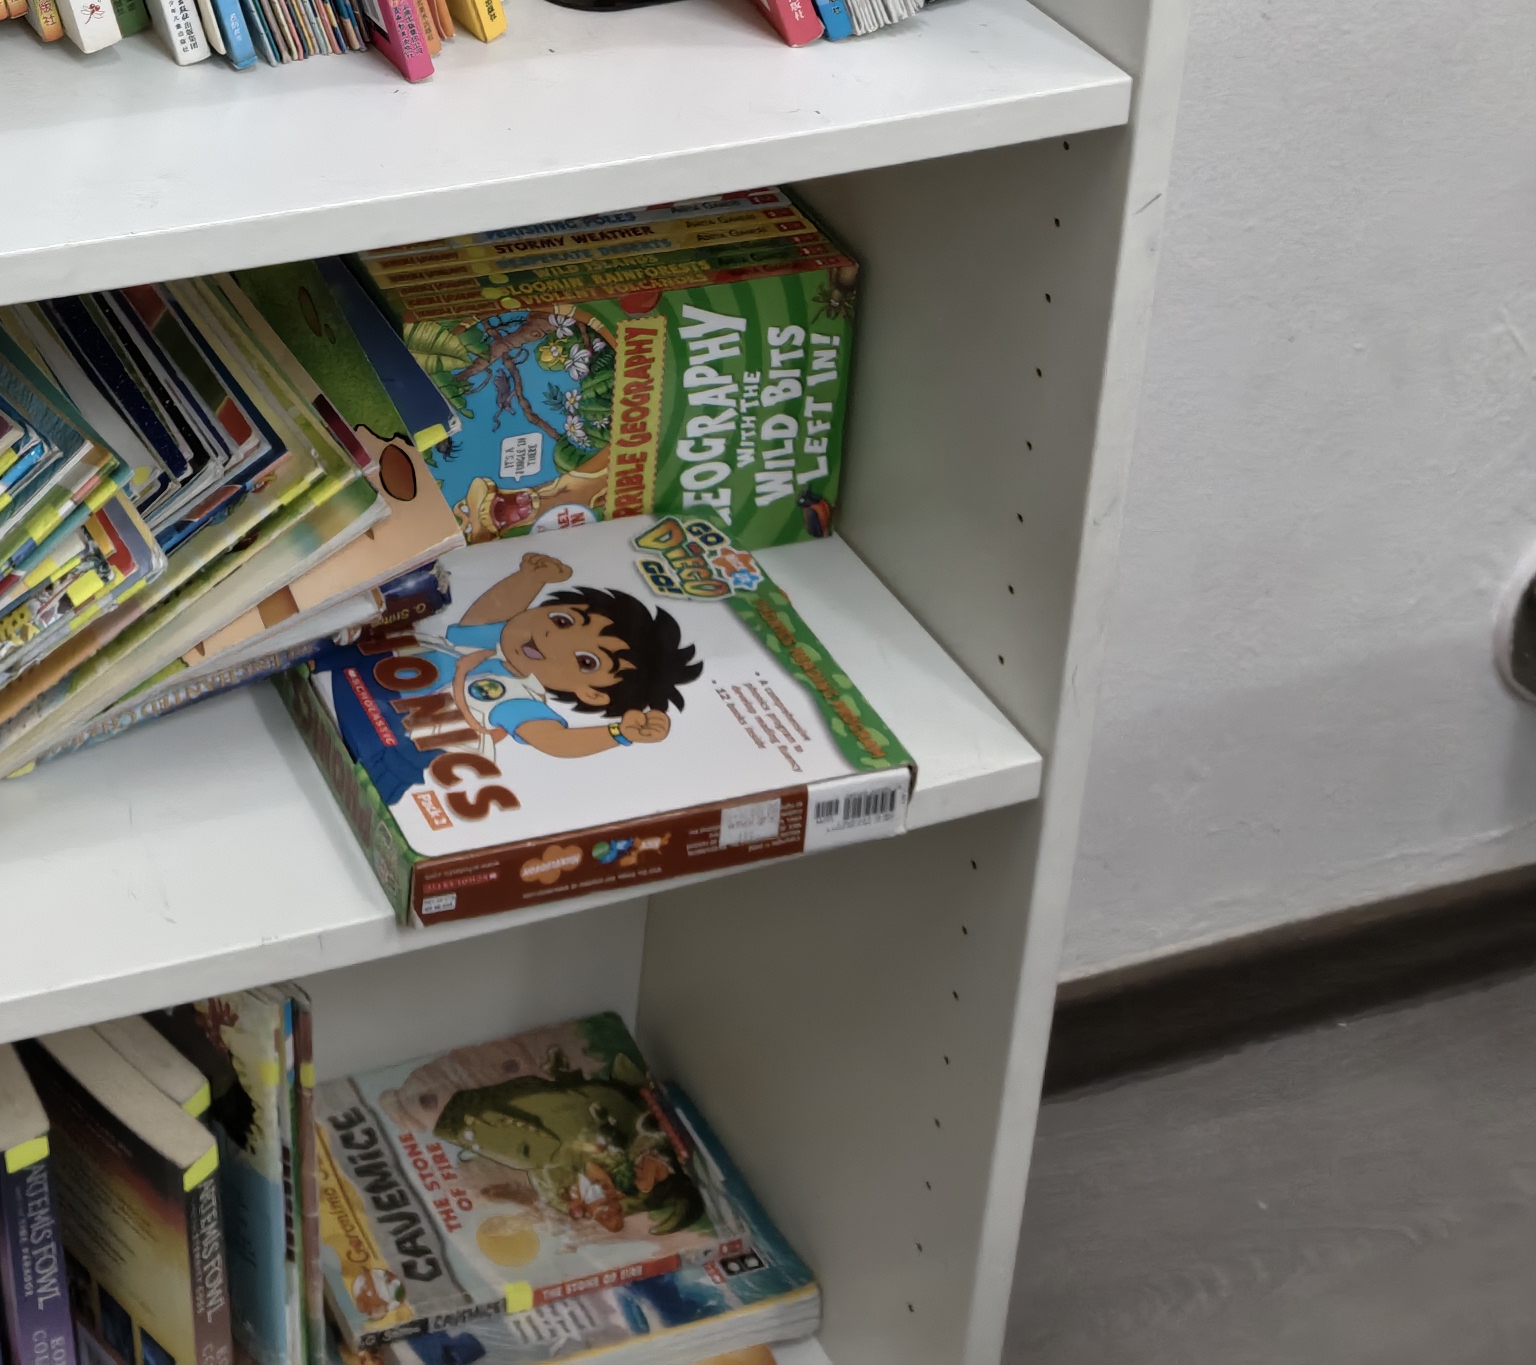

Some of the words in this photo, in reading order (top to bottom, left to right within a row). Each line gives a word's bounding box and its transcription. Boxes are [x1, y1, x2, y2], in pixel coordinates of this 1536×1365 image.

[495, 236, 566, 255] STORMY
[571, 225, 655, 247] WEATHER
[761, 325, 806, 407] BITS
[806, 333, 841, 387] IN!
[616, 327, 658, 448] GEOGRAPHY
[740, 371, 761, 413] THE
[736, 416, 757, 468] WITH
[754, 413, 799, 507] WILD
[796, 396, 833, 486] LEFT
[398, 1131, 442, 1191] STONE
[426, 1142, 457, 1181] FIRE
[327, 1106, 442, 1282] CAVEMICE
[432, 1199, 463, 1234] THE
[451, 1187, 473, 1212] OF
